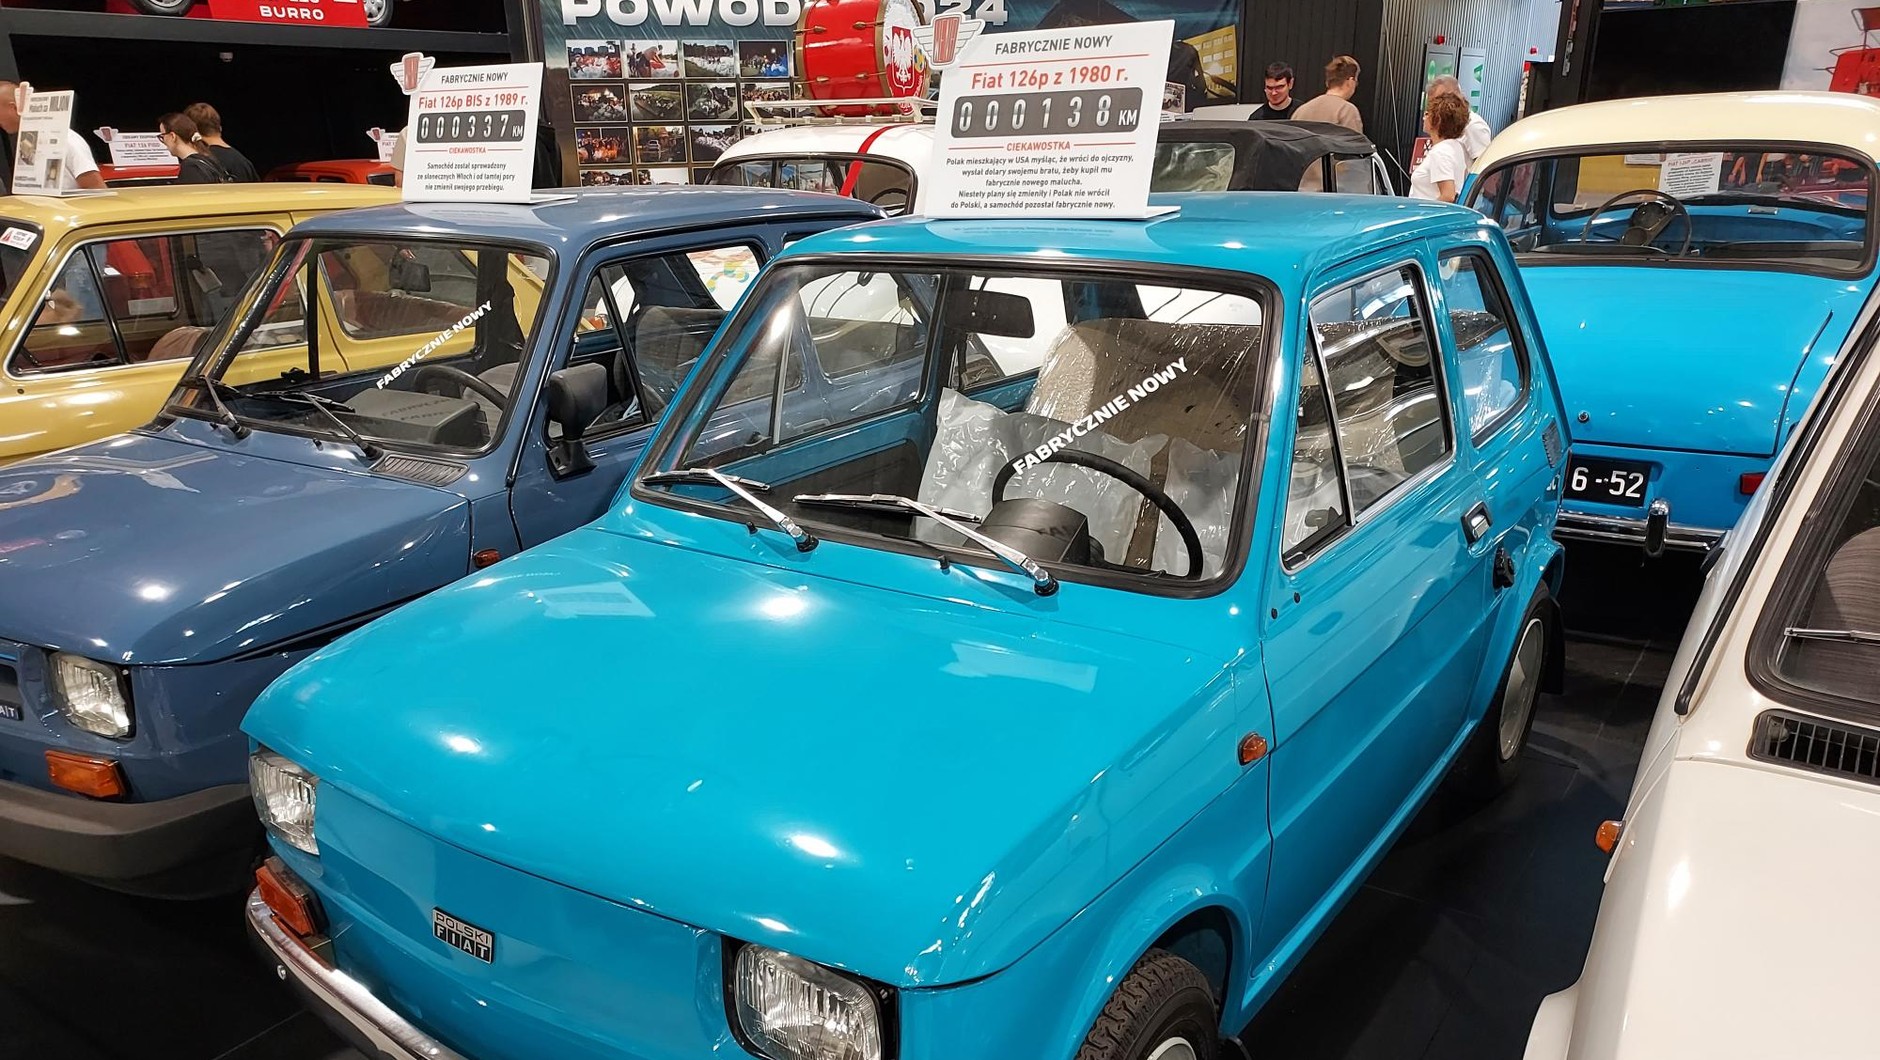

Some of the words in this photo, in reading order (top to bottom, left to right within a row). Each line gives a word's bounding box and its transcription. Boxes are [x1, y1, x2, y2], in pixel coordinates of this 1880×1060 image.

[259, 5, 324, 20] BURRO
[561, 0, 801, 26] POWOD
[994, 38, 1070, 55] FABRYCZNIE
[1074, 35, 1113, 49] NOWY
[441, 74, 484, 84] FABRYCZNIE
[486, 72, 508, 81] NOWY
[972, 72, 1002, 90] Fiat
[1009, 70, 1048, 90] 126p
[1054, 72, 1062, 82] z
[1070, 65, 1110, 83] 1980
[1116, 68, 1128, 81] r.
[419, 97, 437, 109] Fiat
[440, 96, 463, 110] 126p
[466, 95, 482, 107] BIS
[485, 97, 490, 106] z
[494, 93, 517, 106] 1989
[521, 95, 528, 105] r.
[1118, 110, 1137, 125] KM
[512, 126, 523, 137] KM
[1006, 142, 1071, 152] CIEKAWOSTKA
[427, 162, 454, 170] Samochód
[471, 162, 506, 170] sprowadzony
[966, 156, 1006, 165] mieszkający
[1016, 156, 1030, 164] USA
[1031, 156, 1058, 165] myśląc,
[1059, 155, 1068, 163] że
[1101, 154, 1134, 164] ojczyzny,
[985, 168, 1006, 176] dolary
[1007, 168, 1038, 176] swojemu
[1040, 167, 1060, 175] bratu,
[1062, 166, 1079, 175] żeby
[1081, 166, 1099, 174] kupił
[476, 184, 504, 192] przebiegu.
[986, 179, 1021, 187] fabrycznie
[1022, 179, 1048, 187] nowego
[1050, 178, 1082, 186] malucha.
[958, 190, 986, 198] Niestety
[987, 190, 1005, 198] plany
[1007, 190, 1016, 198] się
[1025, 201, 1054, 209] pozostał
[1056, 201, 1092, 209] fabrycznie
[376, 328, 454, 390] FABRYCZNIE
[452, 300, 492, 333] NOWY
[1012, 394, 1130, 476] FABRYCZNIE
[1127, 356, 1189, 403] NOWY
[435, 912, 488, 944] POLSKI
[436, 925, 488, 958] FIAT
